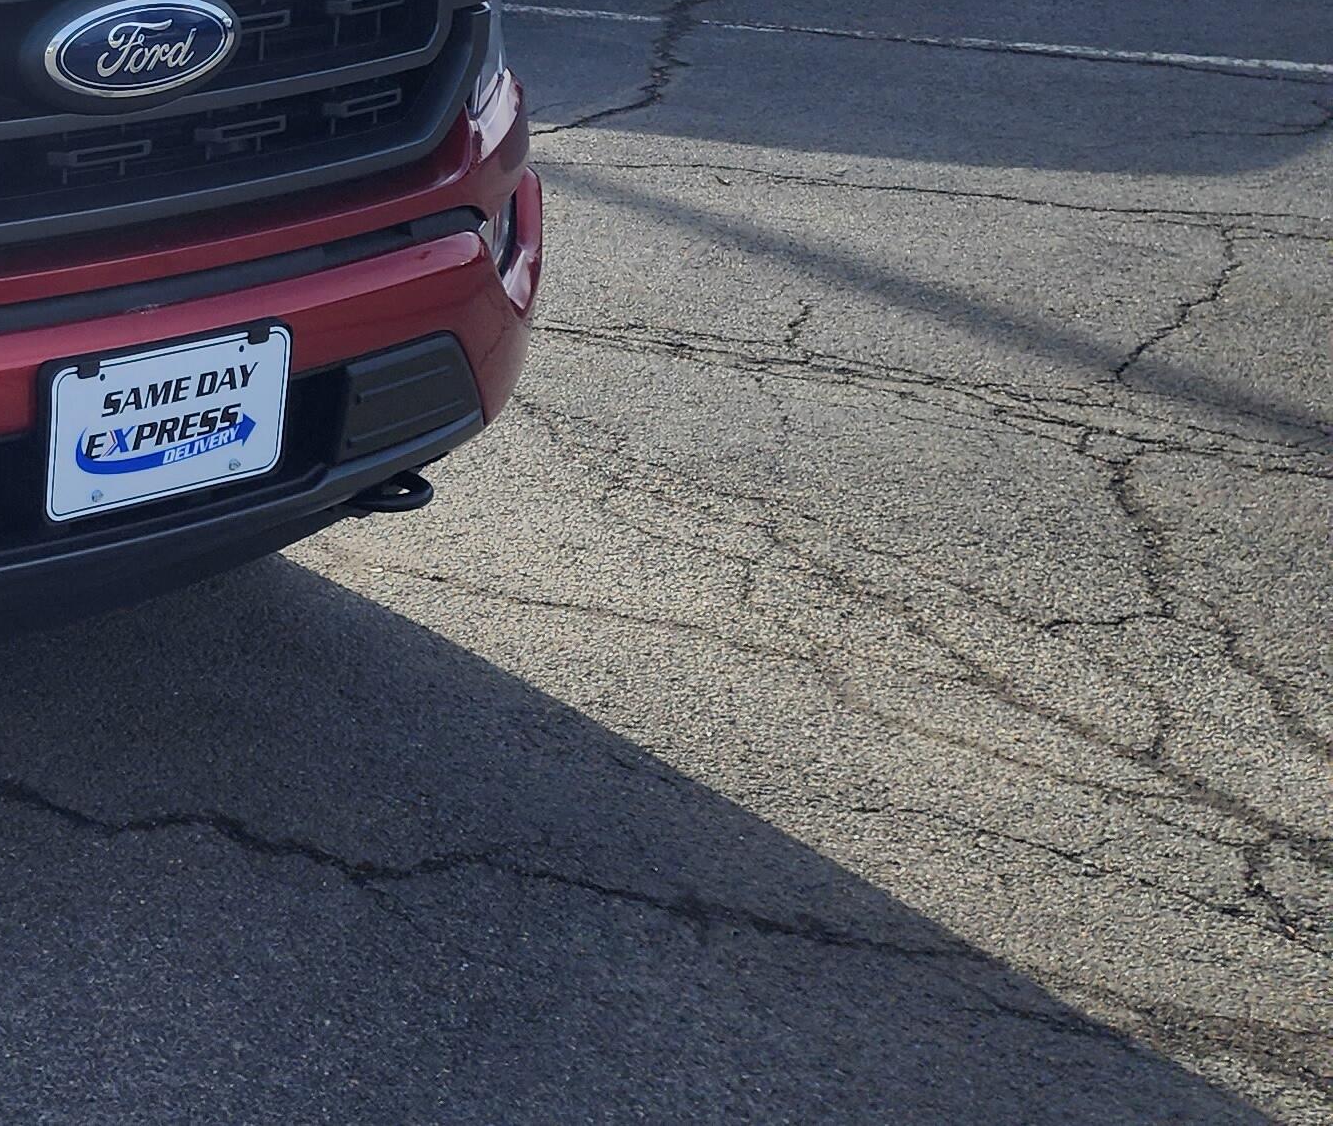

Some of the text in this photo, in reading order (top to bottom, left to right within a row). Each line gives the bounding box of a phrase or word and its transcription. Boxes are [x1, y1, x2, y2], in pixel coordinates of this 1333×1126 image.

[96, 18, 197, 78] Ford
[101, 362, 259, 417] SAME DAY
[85, 403, 242, 461] EXPRESS
[162, 425, 241, 465] DELIVERY
